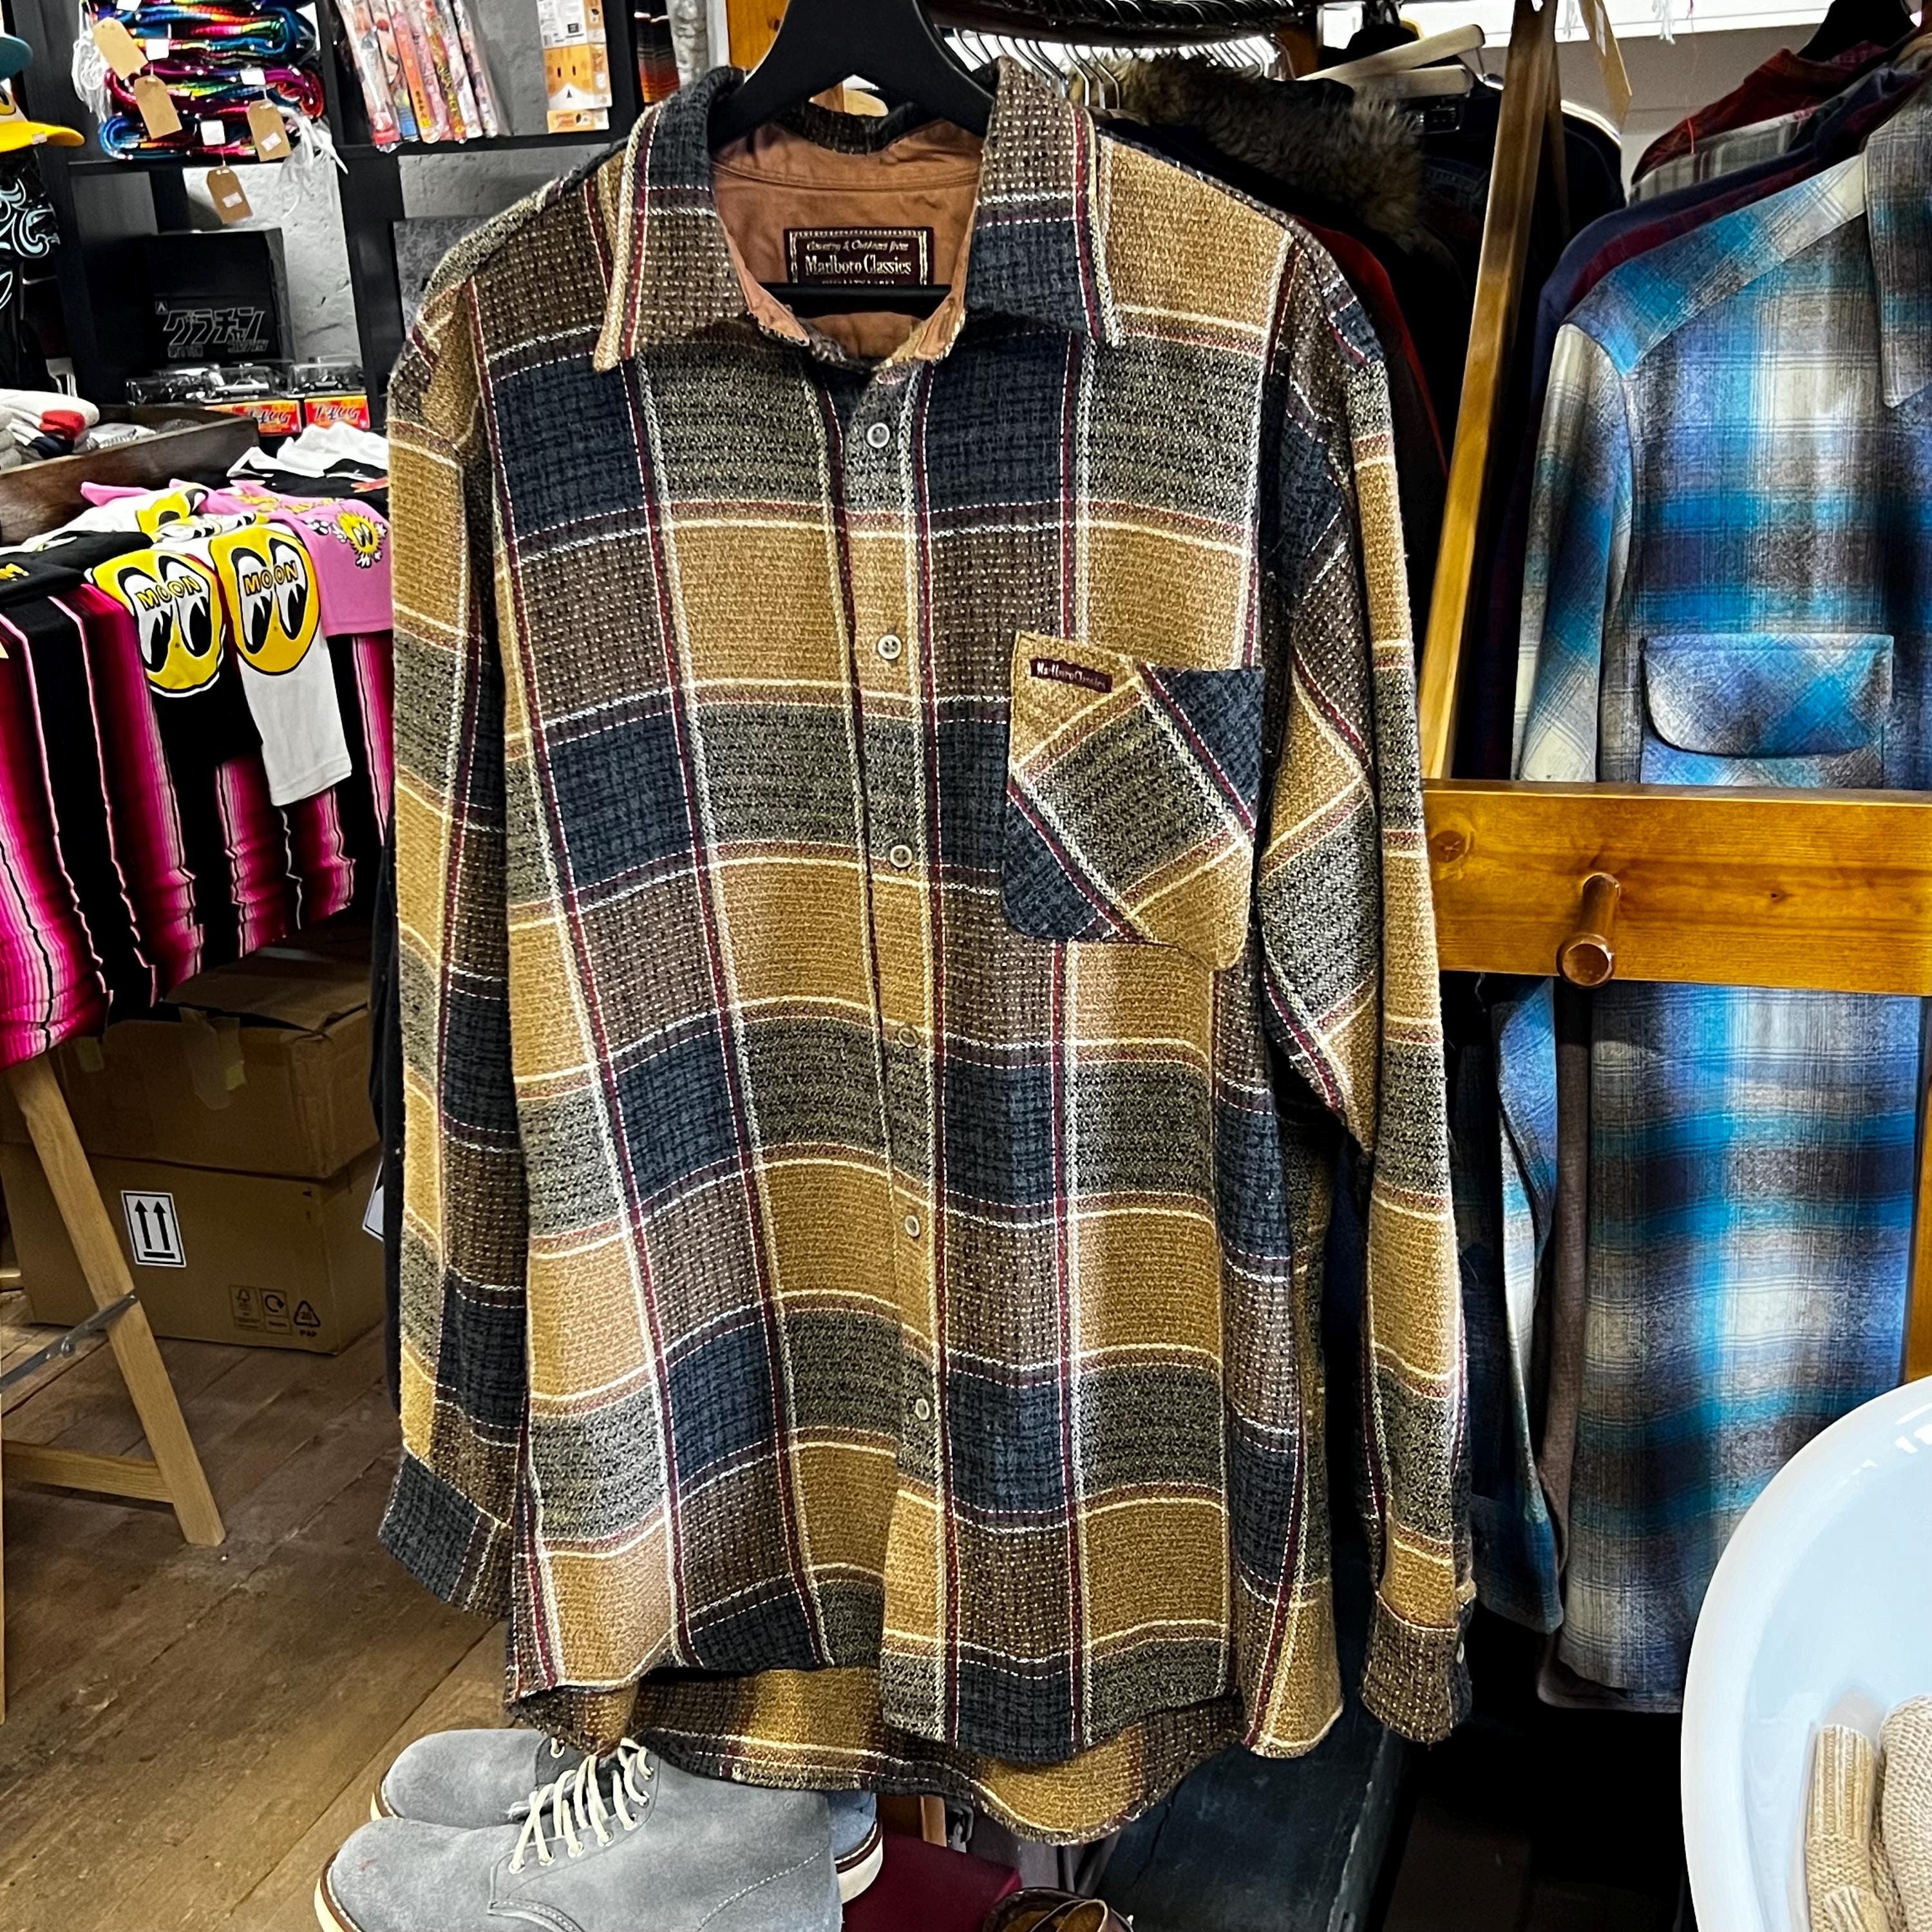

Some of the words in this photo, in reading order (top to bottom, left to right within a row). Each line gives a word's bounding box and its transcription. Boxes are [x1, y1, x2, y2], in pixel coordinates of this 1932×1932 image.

[805, 255, 862, 276] Marlboro
[864, 254, 912, 276] Classics
[135, 575, 203, 611] MOON
[243, 560, 299, 596] MOON
